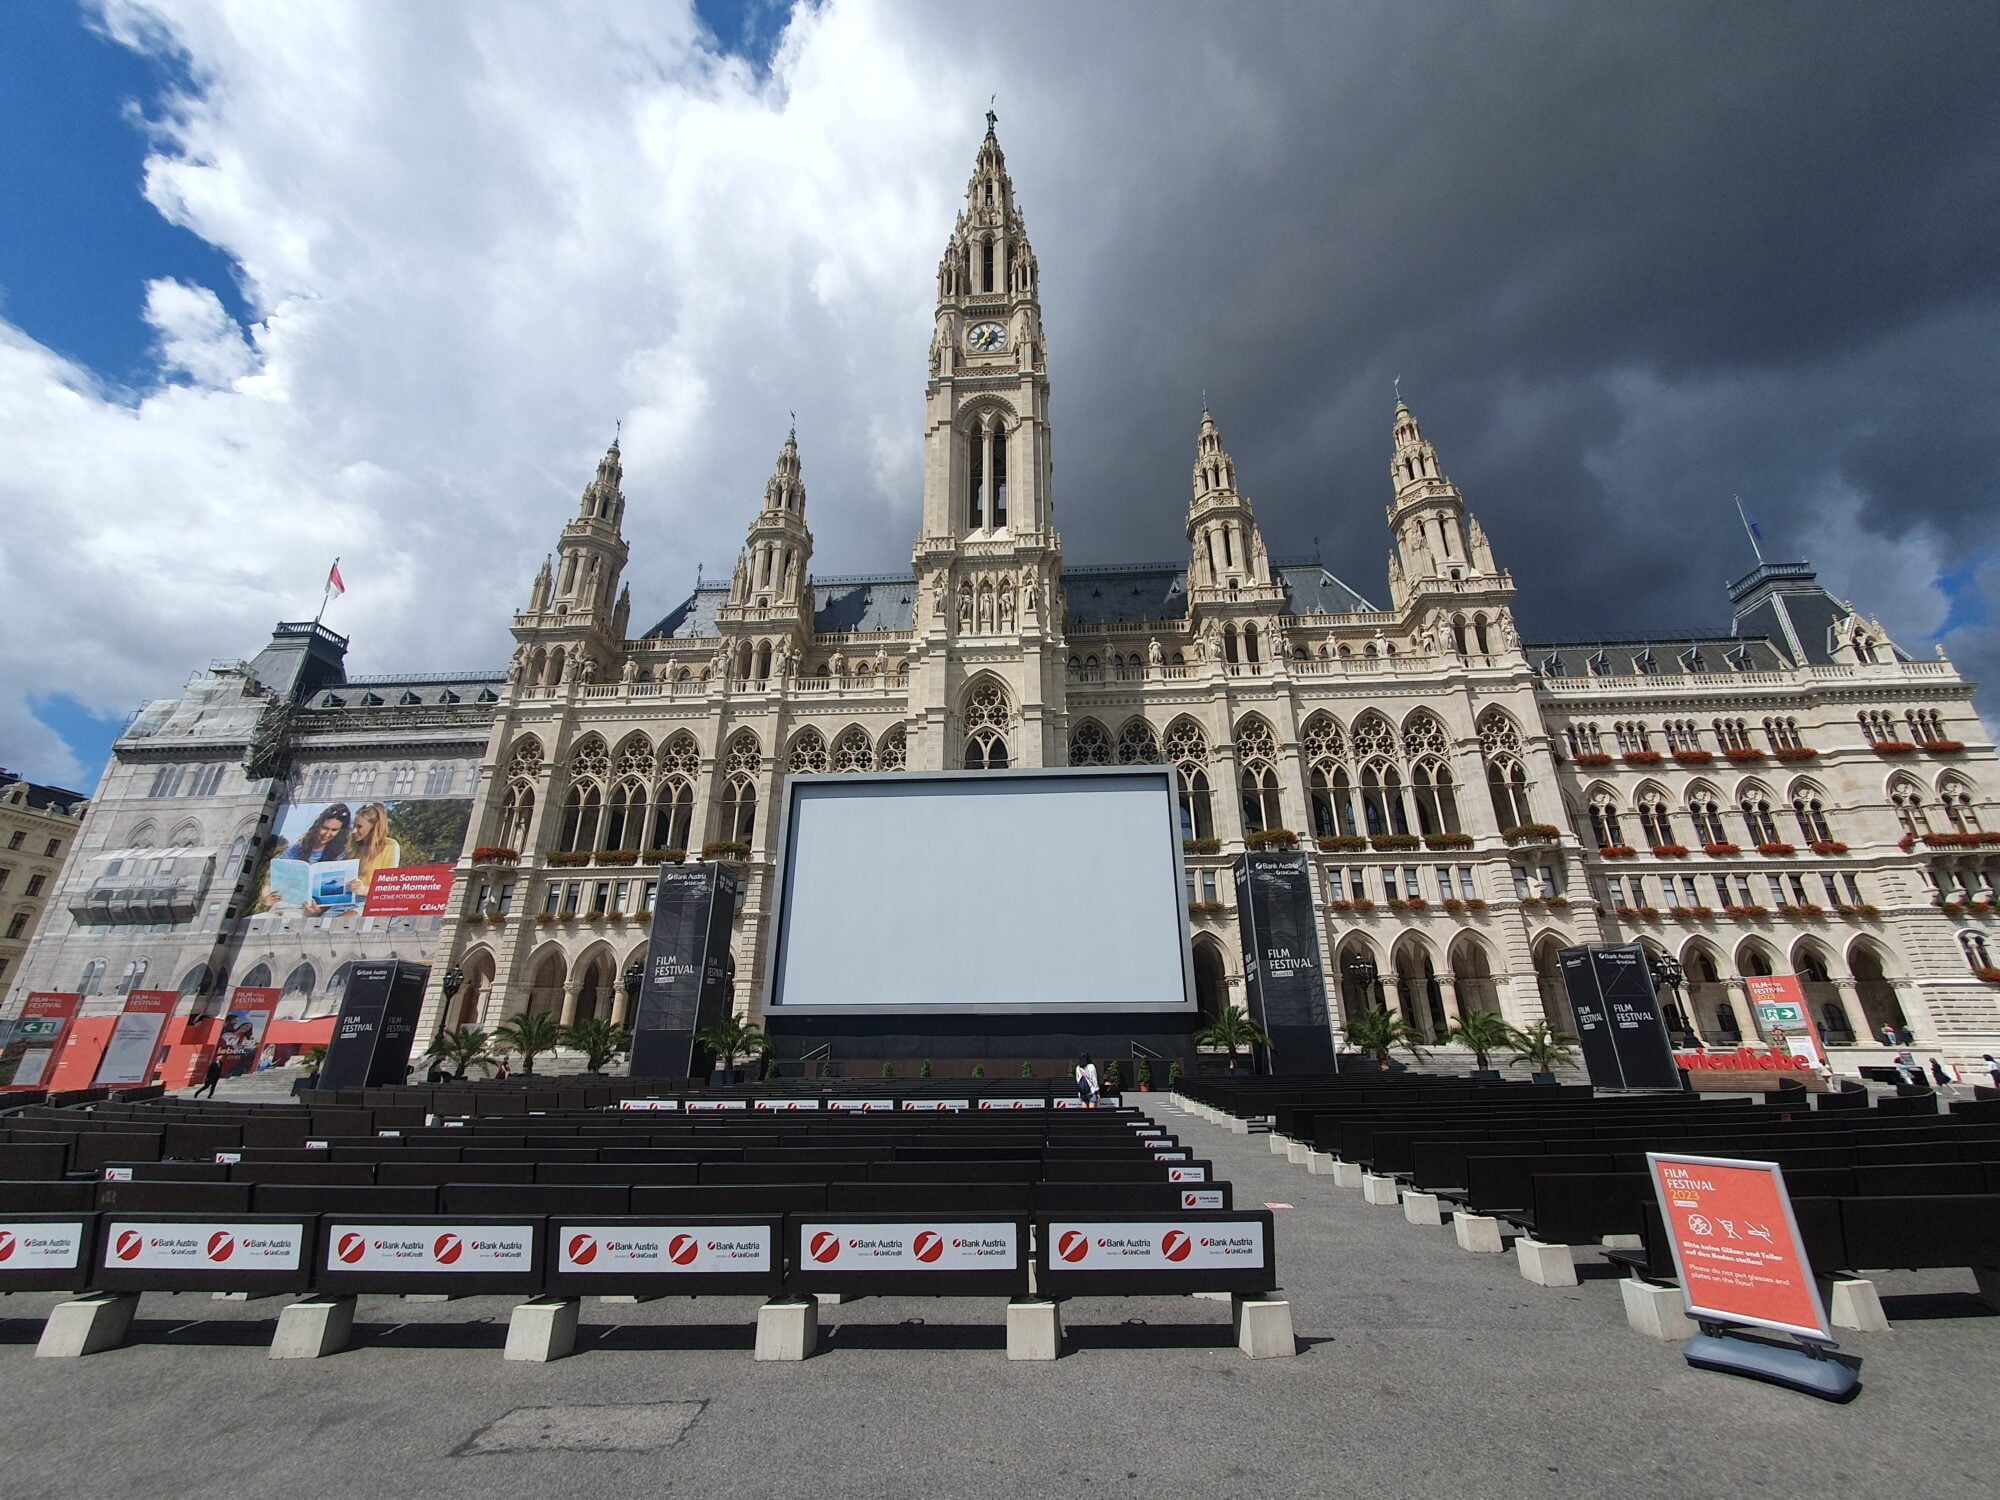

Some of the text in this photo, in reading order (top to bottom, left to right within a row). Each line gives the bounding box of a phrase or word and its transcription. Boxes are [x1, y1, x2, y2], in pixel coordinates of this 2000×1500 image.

[378, 874, 398, 882] Mein
[1268, 948, 1290, 958] FILM
[656, 956, 676, 966] FILM
[1270, 958, 1313, 970] FESTIVAL
[655, 965, 694, 976] FESTIVAL
[1578, 1006, 1591, 1015] FILM
[1614, 1003, 1633, 1012] FILM
[344, 1016, 361, 1024] FILM
[1580, 1013, 1603, 1023] FESTIVAL
[1616, 1012, 1654, 1021] FESTIVAL
[342, 1023, 373, 1032] FESTIVAL
[1674, 1047, 1810, 1071] wienliebe
[1664, 1168, 1689, 1178] FILM
[1667, 1179, 1716, 1191] FESTIVAL
[1670, 1190, 1700, 1200] 2023
[382, 1241, 424, 1250] Bank Austria
[480, 1241, 522, 1250] Bank Austria
[615, 1242, 658, 1250] Bank Austria
[716, 1242, 759, 1250] Bank Austria
[858, 1240, 902, 1248] Bank Austria
[962, 1239, 1006, 1248] Bank Austria
[1106, 1239, 1150, 1247] Bank Austria
[1229, 1238, 1252, 1246] Austria
[1701, 1244, 1720, 1252] keine
[1721, 1246, 1744, 1255] Gläser
[1760, 1252, 1782, 1260] Teller
[1712, 1253, 1735, 1261] Boden
[1736, 1257, 1764, 1266] stellen!
[1689, 1264, 1710, 1272] Please
[1748, 1274, 1774, 1283] glasses
[1692, 1272, 1711, 1280] plates
[1735, 1278, 1753, 1287] floor!
